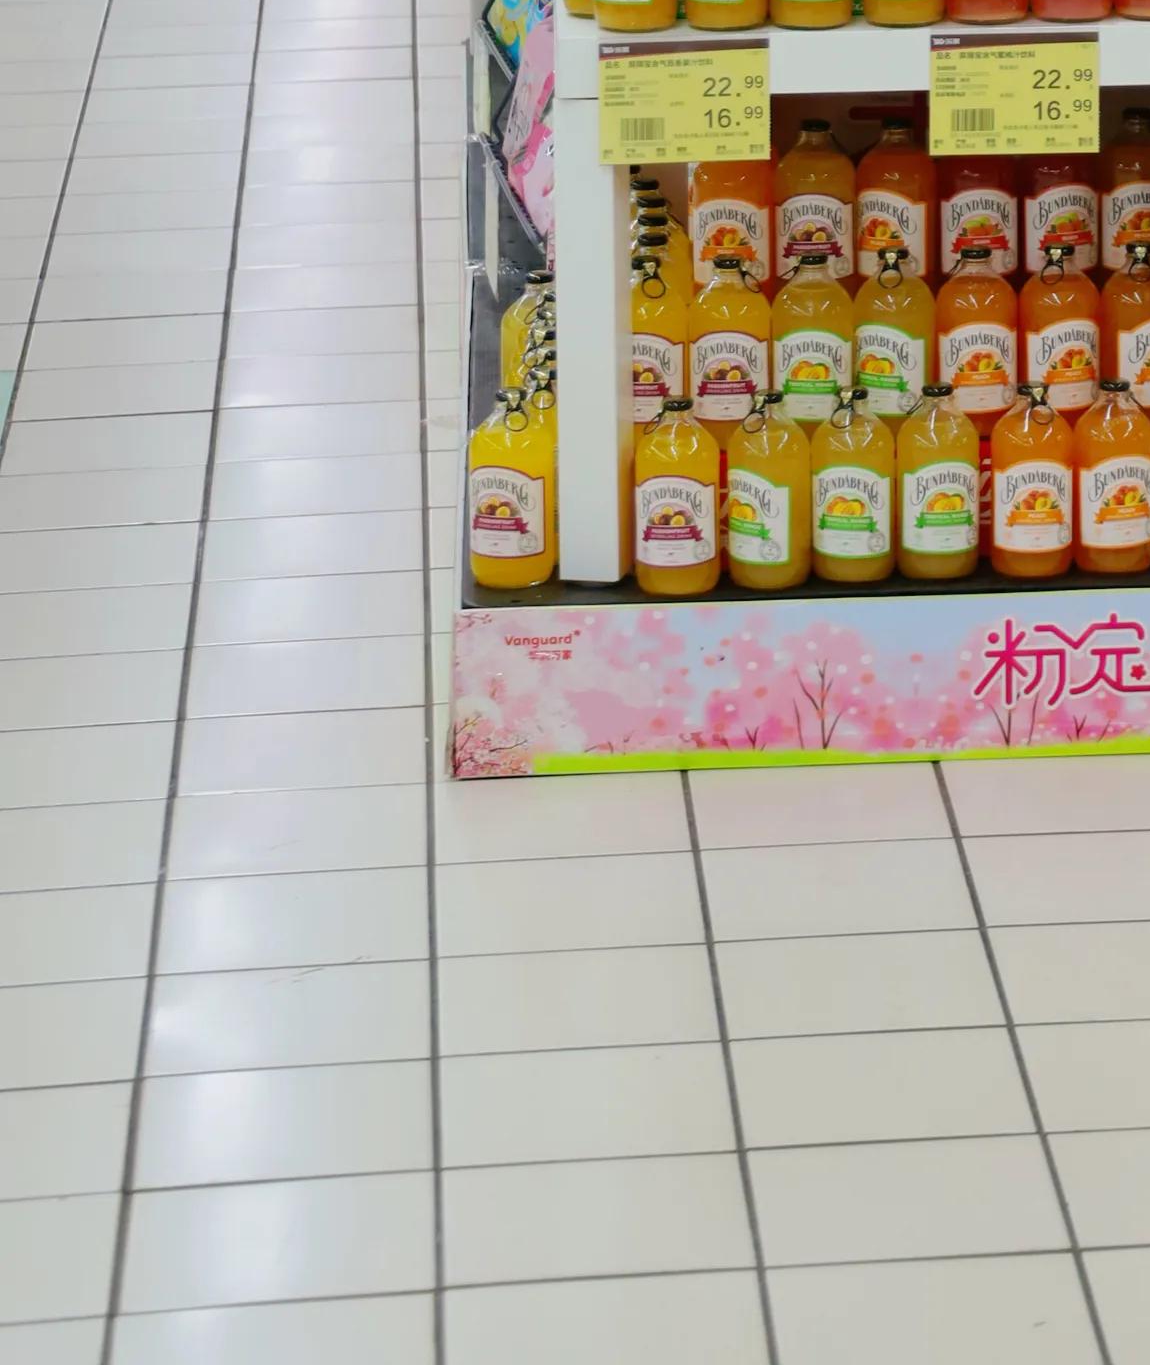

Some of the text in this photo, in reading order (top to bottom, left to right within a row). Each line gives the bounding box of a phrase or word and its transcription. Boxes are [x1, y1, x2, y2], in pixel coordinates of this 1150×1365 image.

[702, 75, 764, 98] 22.99
[1032, 68, 1093, 90] 22.99
[703, 106, 764, 129] 16.99
[1033, 99, 1093, 121] 16.99
[504, 633, 573, 648] Vanguard
